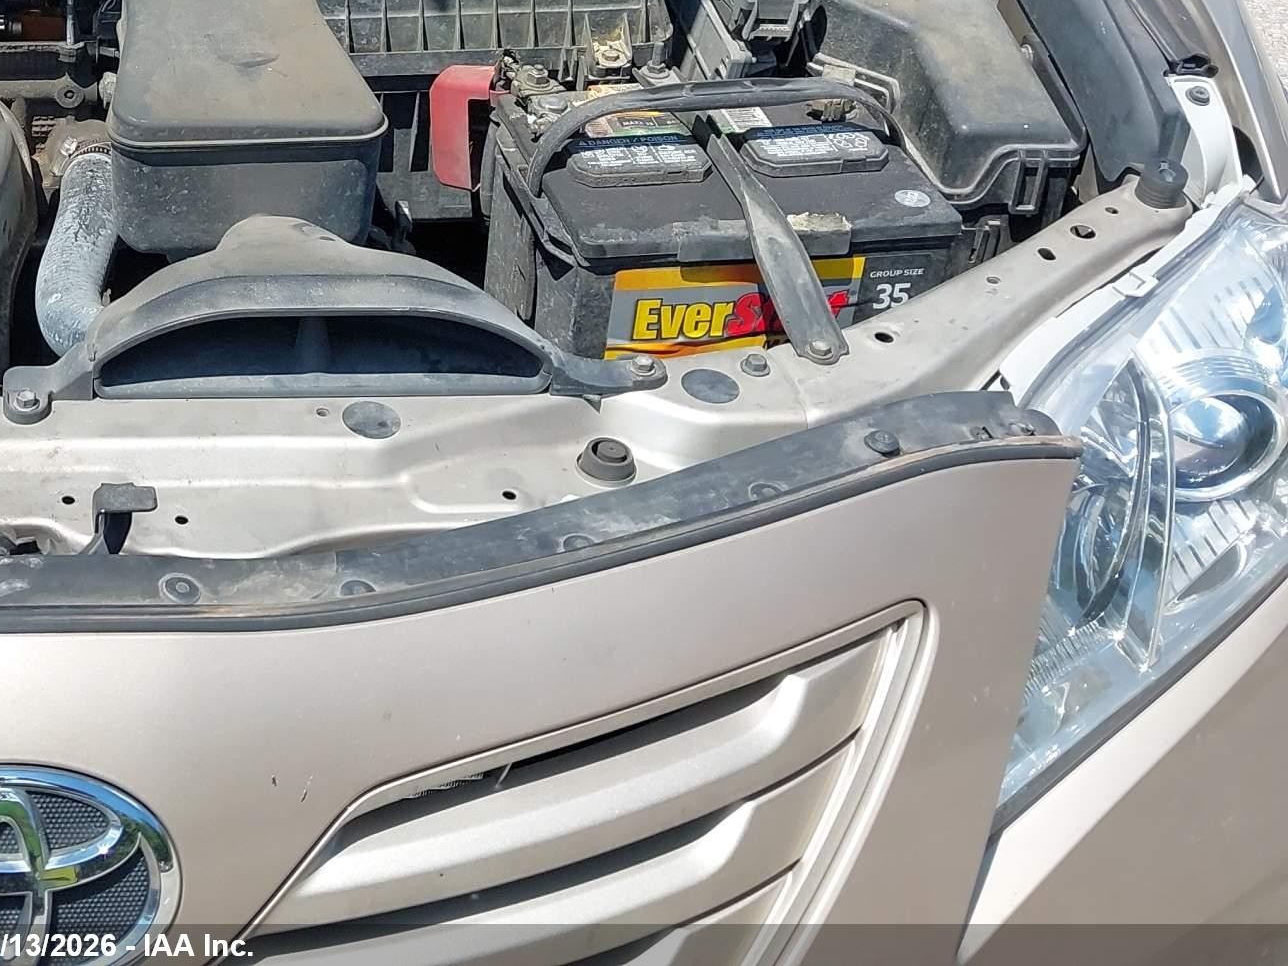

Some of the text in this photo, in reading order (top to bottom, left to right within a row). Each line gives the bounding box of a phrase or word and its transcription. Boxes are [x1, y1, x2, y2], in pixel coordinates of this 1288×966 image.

[869, 267, 925, 279] GROUP SIZE
[872, 282, 911, 310] 35
